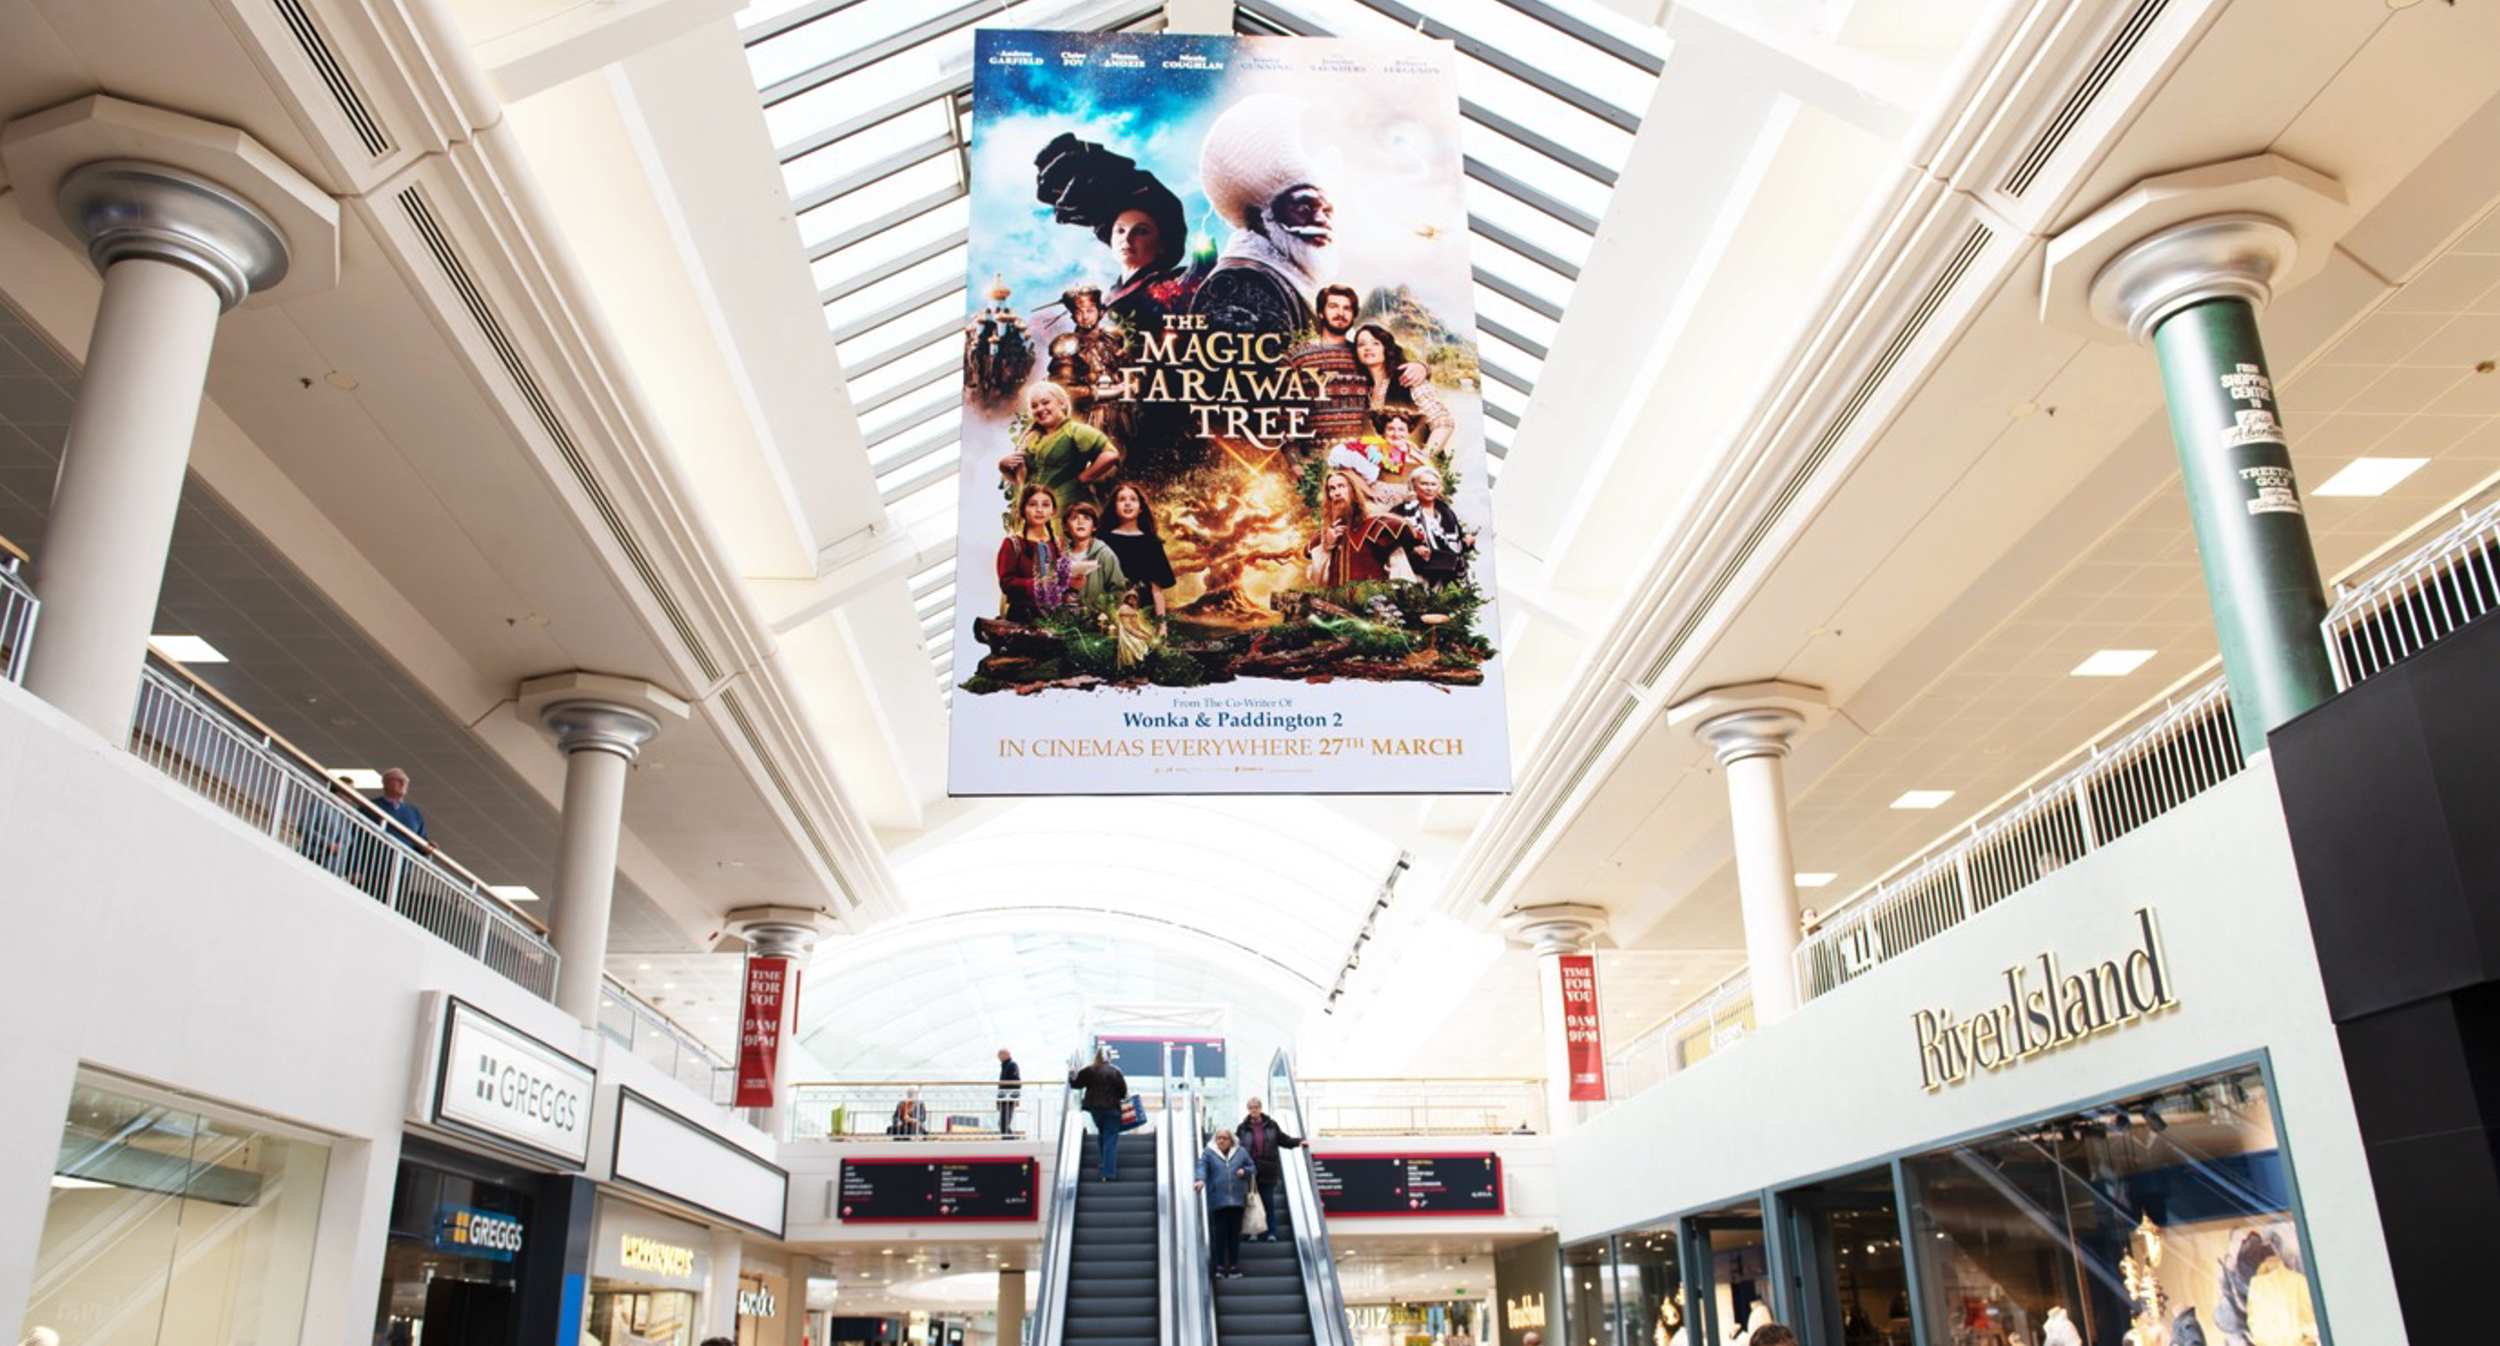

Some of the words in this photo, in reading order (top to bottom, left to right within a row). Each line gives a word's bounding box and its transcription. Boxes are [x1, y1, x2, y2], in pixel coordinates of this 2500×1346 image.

[989, 57, 1044, 65] GARFIELD
[1063, 59, 1084, 67] FOY
[1104, 60, 1145, 68] ANOZIE
[1162, 61, 1224, 70] COUGHLAN
[1163, 314, 1209, 330] THE
[1136, 331, 1284, 372] MAGIC
[1118, 366, 1335, 403] FARAWAY
[1190, 404, 1316, 450] TREE
[1173, 698, 1200, 707] From
[1204, 698, 1223, 707] The
[1225, 698, 1276, 707] Co-Writer
[1279, 698, 1293, 707] Of
[1123, 712, 1189, 727] Wonka
[1195, 712, 1212, 727] &
[1218, 712, 1327, 732] Paddington
[1333, 713, 1343, 727] 2
[999, 739, 1025, 757] IN
[1032, 739, 1145, 757] CINEMAS
[1151, 738, 1313, 757] EVERYWHERE
[1372, 738, 1463, 756] MARCH
[751, 970, 782, 981] TIME
[1562, 967, 1592, 977] TIME
[751, 981, 781, 993] FOR
[1564, 978, 1592, 989] FOR
[750, 994, 779, 1006] YOU
[1565, 990, 1593, 1002] YOU
[499, 1065, 577, 1133] GREGGS
[469, 1214, 523, 1252] GREGGS
